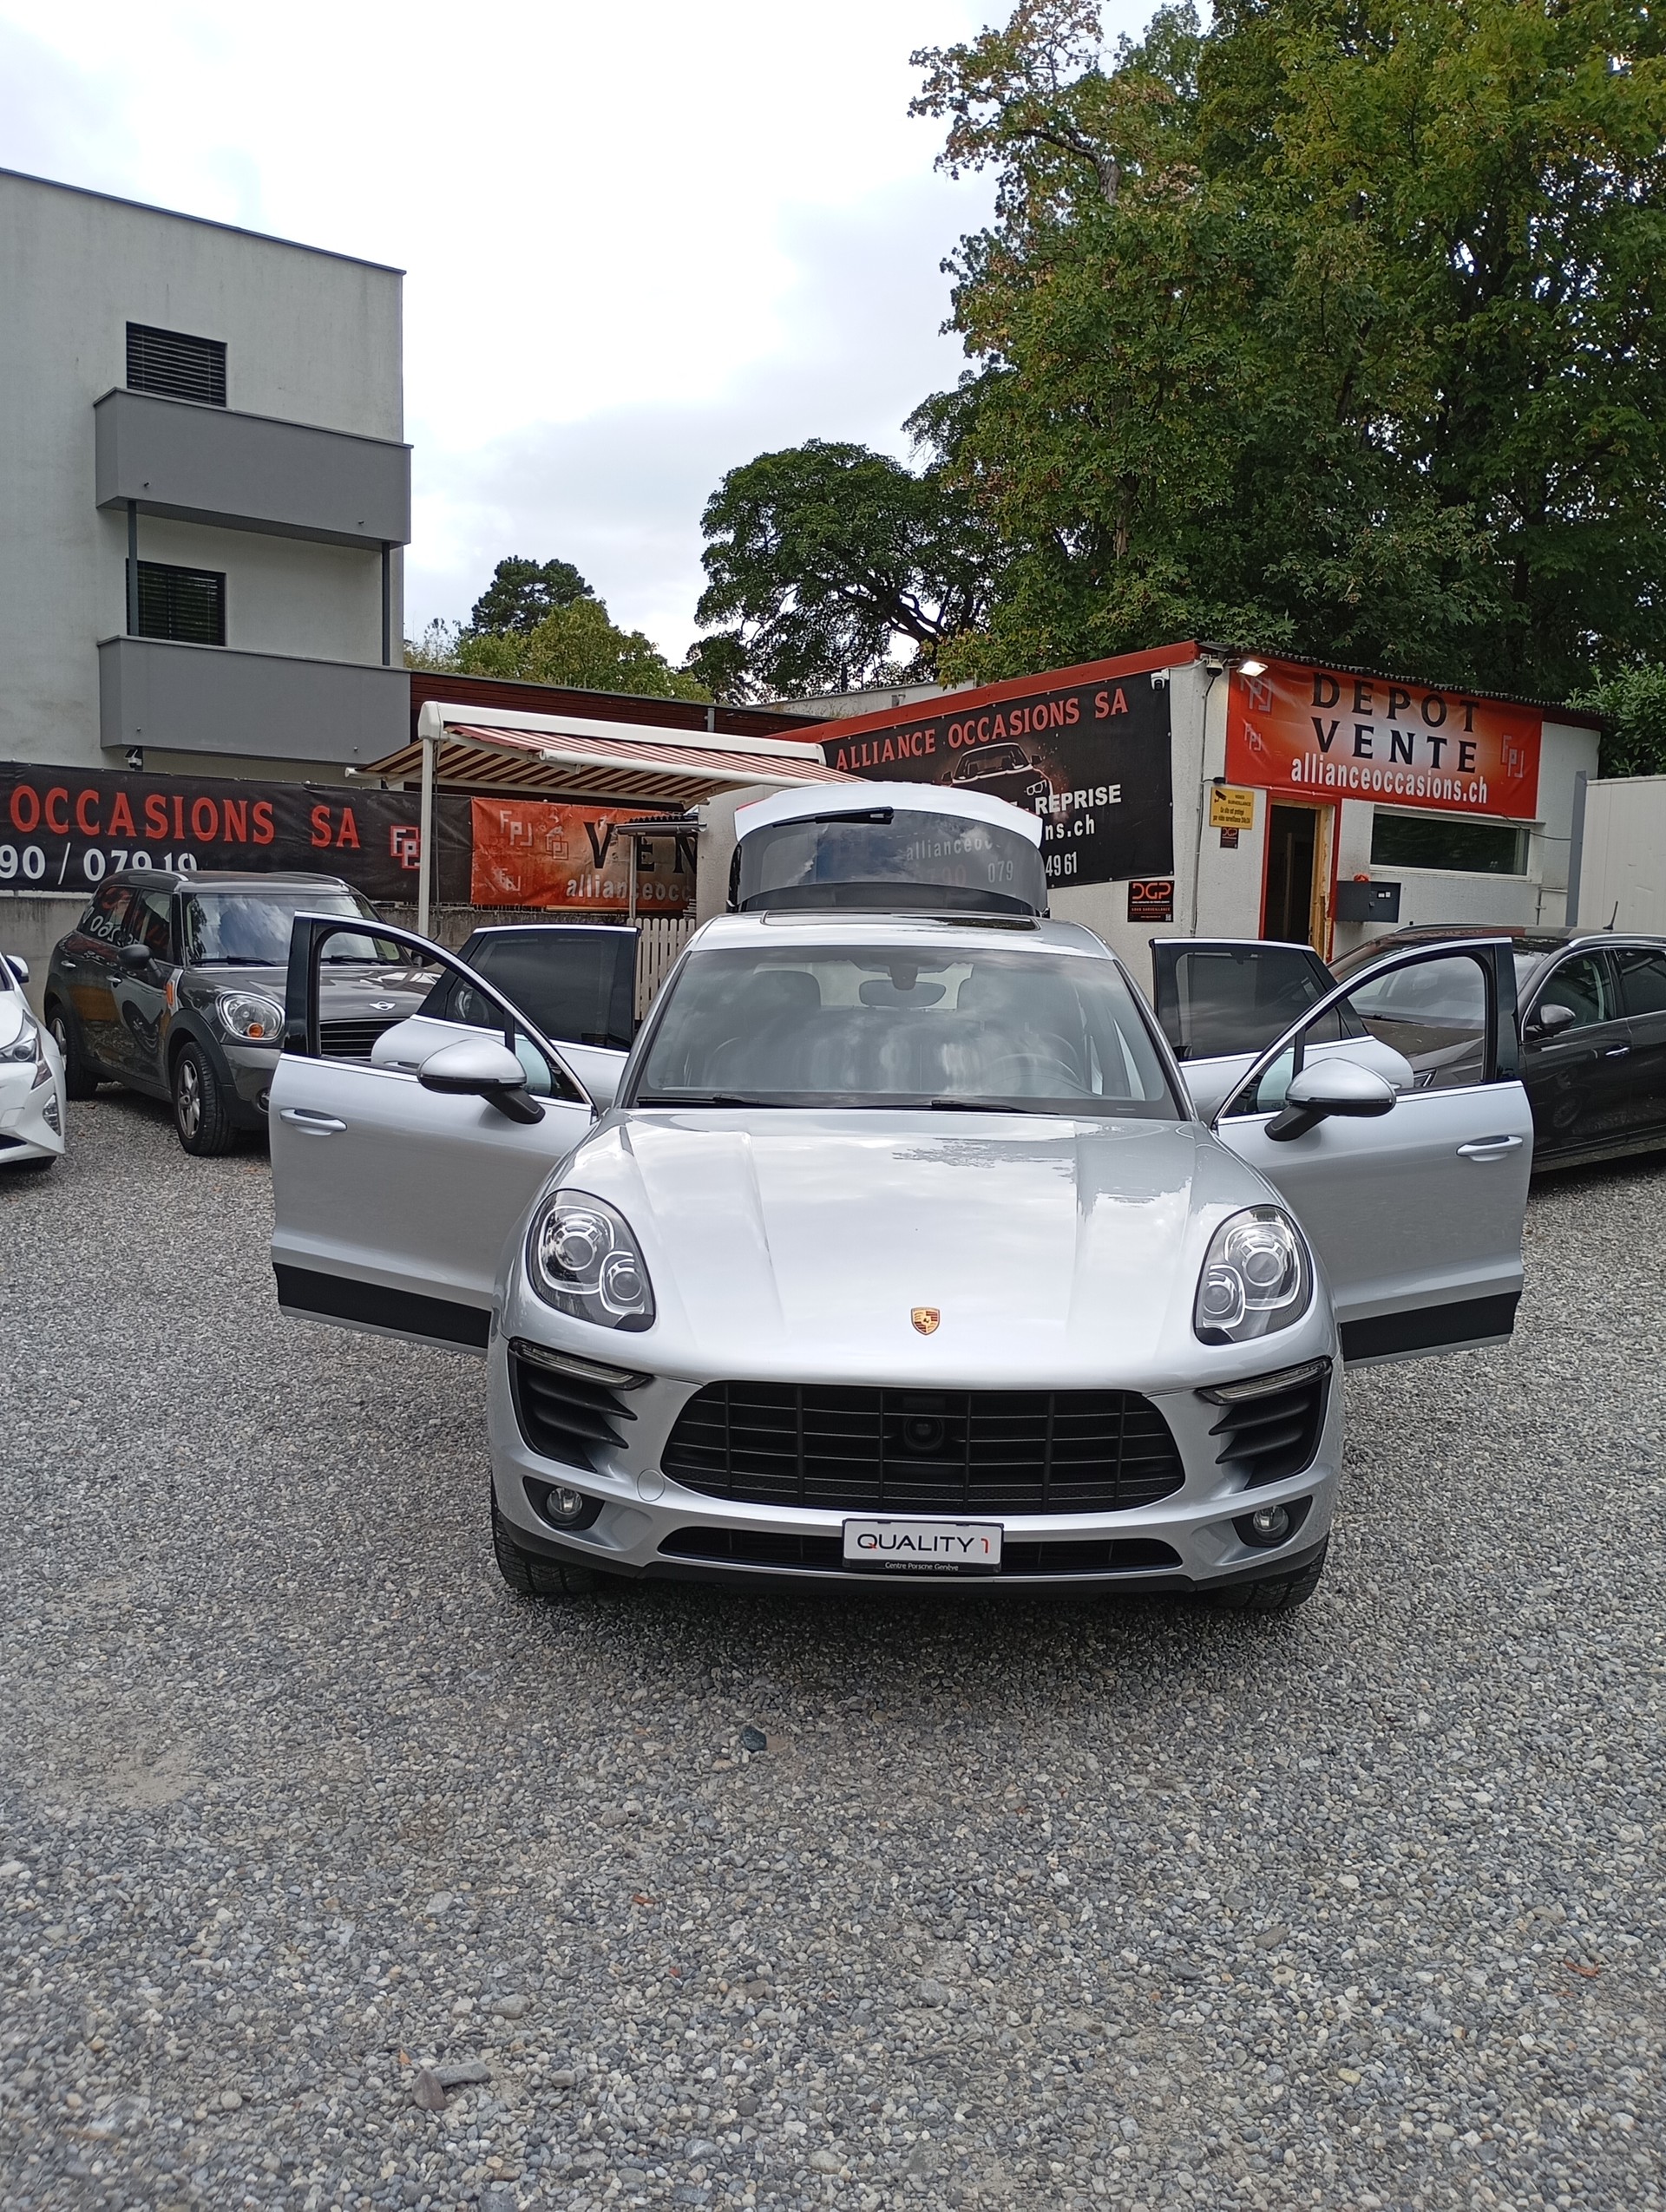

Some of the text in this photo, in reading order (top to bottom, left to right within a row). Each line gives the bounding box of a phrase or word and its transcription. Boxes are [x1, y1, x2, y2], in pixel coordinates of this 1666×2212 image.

[836, 688, 1128, 771] ALLIANCE OCCASIONS SA
[1311, 717, 1478, 773] VENTE
[1035, 784, 1122, 815] REPRISE
[1291, 752, 1488, 803] allianceoccasions.ch
[10, 785, 360, 848] OCCASIONS SA
[1132, 882, 1171, 900] DGP
[856, 1534, 991, 1554] QUALITY 1
